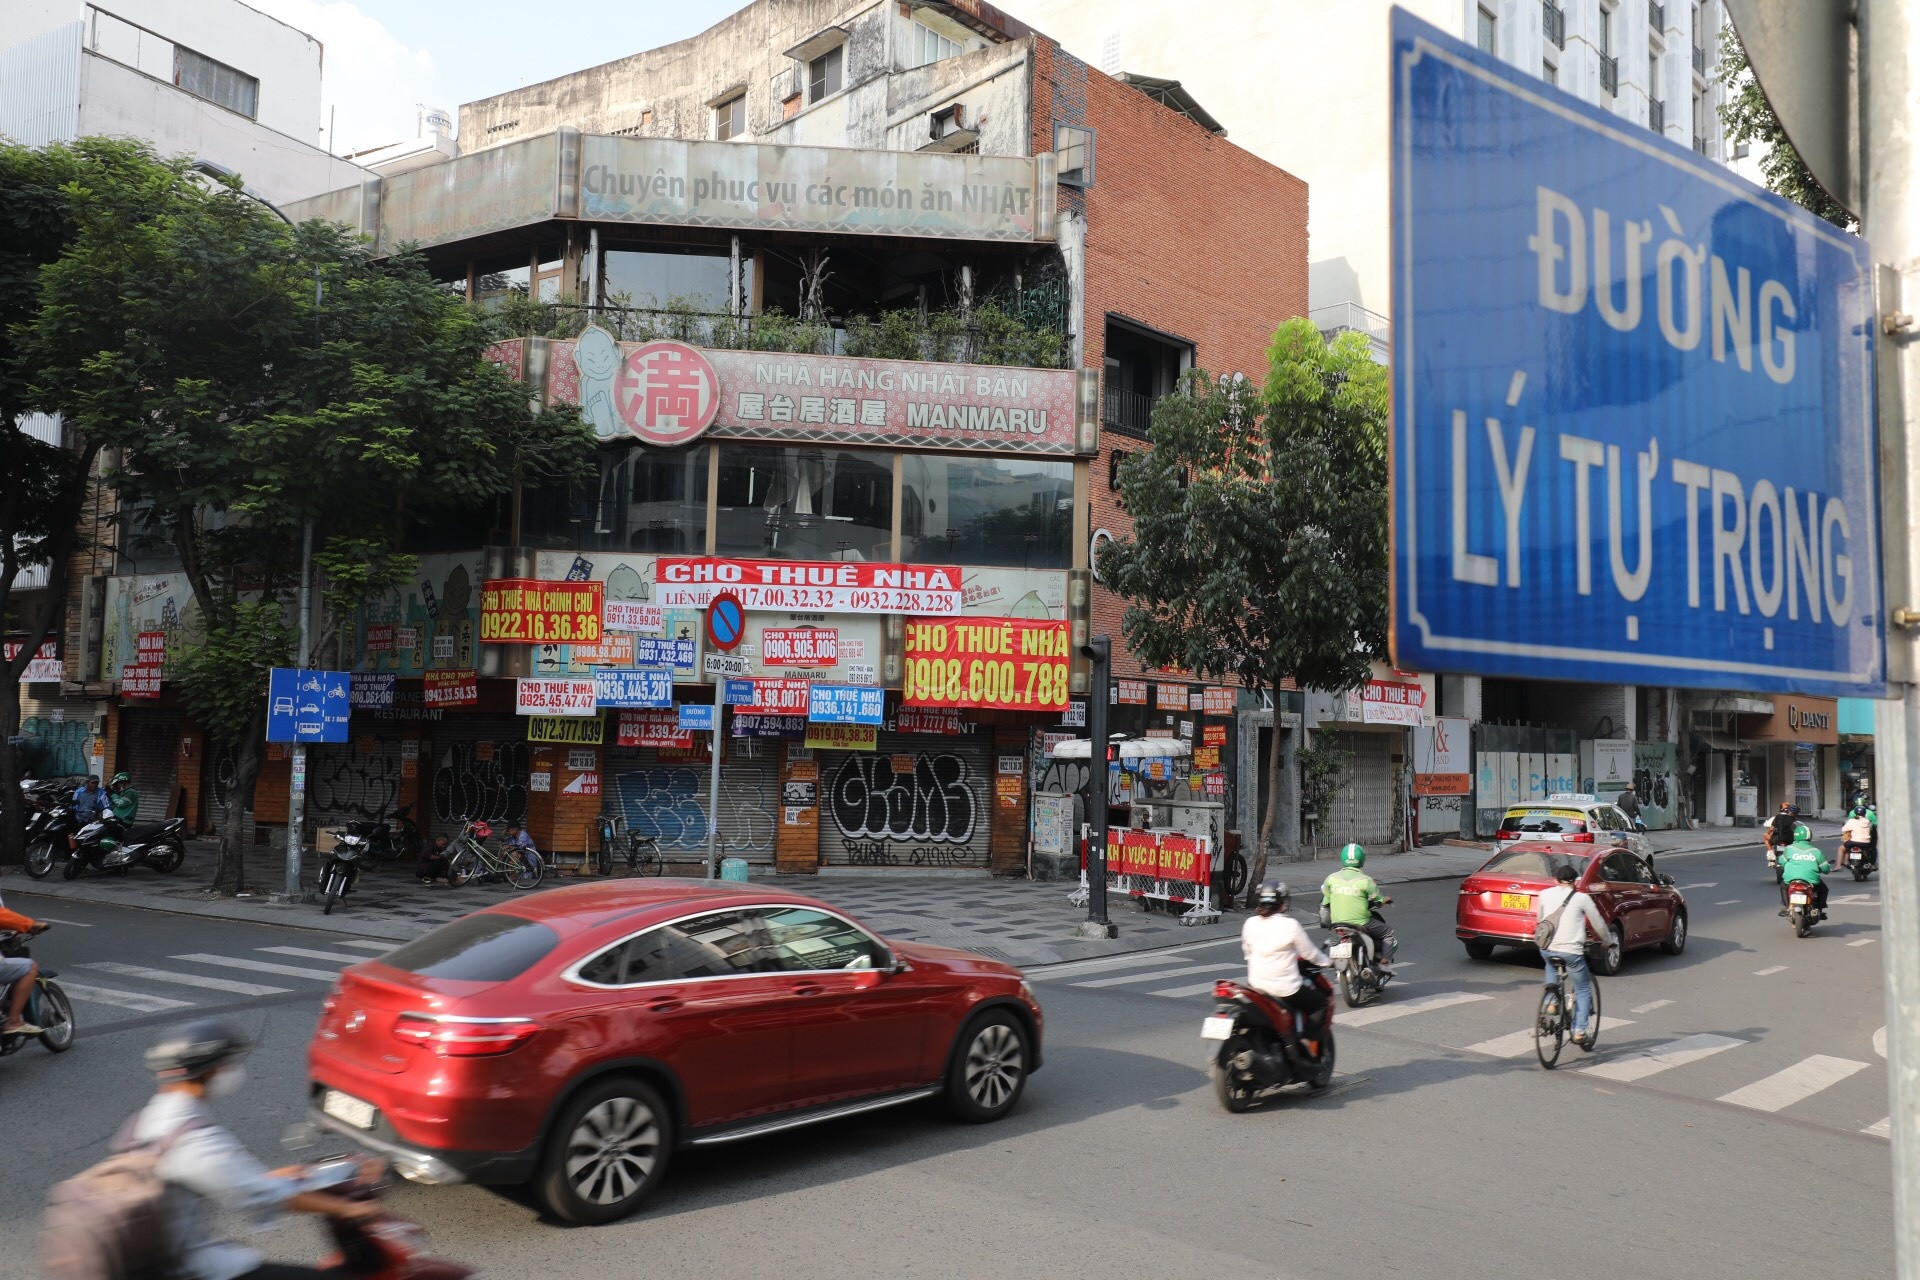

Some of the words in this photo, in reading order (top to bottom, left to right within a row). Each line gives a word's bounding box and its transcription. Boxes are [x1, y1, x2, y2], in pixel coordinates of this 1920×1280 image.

[584, 163, 685, 206] Chuyên
[765, 181, 797, 212] vụ
[805, 176, 847, 206] các
[853, 176, 913, 210] món
[920, 180, 953, 212] ăn
[960, 184, 1030, 221] NHẬT
[1528, 185, 1796, 385] ĐƯỜNG
[756, 361, 814, 388] NHÀ
[819, 362, 895, 391] HÀNG
[901, 369, 971, 402] NHẬT
[976, 366, 1029, 398] BẢN
[737, 393, 888, 427] 屋台居酒屋
[906, 400, 1048, 435] MANMARU
[1452, 370, 1535, 590] LÝ
[1559, 436, 1660, 642] TỰ
[1672, 459, 1853, 650] TRỌNG
[666, 564, 742, 584] CHO
[756, 564, 859, 587] THUÊ
[874, 566, 953, 590] NHÀ
[482, 591, 499, 611] CHO
[501, 585, 523, 611] THUÊ
[525, 587, 542, 611] NHÀ
[543, 587, 572, 612] CHÍNH
[666, 589, 697, 605] LIÊN
[850, 590, 954, 612] 0932.228.228
[607, 605, 622, 614] CHO
[625, 604, 644, 615] THUÊ
[646, 605, 661, 616] NHÀ
[480, 612, 598, 641] 0922.16.36.36
[606, 613, 661, 627] 0911.33.99.04
[139, 634, 151, 649] NHÀ
[152, 634, 164, 650] BÁN
[615, 636, 631, 646] NHÀ
[788, 631, 812, 639] THUÊ
[815, 630, 836, 639] NHÀ
[905, 623, 948, 653] CHO
[955, 621, 1014, 655] THUÊ
[1021, 624, 1068, 657] NHÀ
[576, 645, 631, 659] 0906.98.0017
[640, 640, 655, 649] CHO
[657, 639, 675, 649] THUÊ
[677, 640, 693, 651] NHÀ
[764, 640, 836, 659] 0906.905.006
[639, 648, 693, 663] 0931.432.469
[363, 674, 376, 682] BÁN
[425, 672, 440, 680] NHÀ
[441, 671, 455, 680] CHO
[457, 670, 475, 680] THUÊ
[597, 672, 618, 681] CHO
[622, 671, 646, 681] THUÊ
[649, 671, 671, 681] NHÀ
[784, 671, 826, 680] MANMARU
[905, 657, 1068, 706] 0908.600.788
[354, 683, 367, 691] CHO
[369, 682, 387, 691] THUÊ
[519, 682, 541, 693] CHO
[544, 681, 569, 694] THUÊ
[573, 682, 594, 694] NHÀ
[597, 681, 671, 701] 0936.445.201
[760, 680, 784, 688] THUÊ
[787, 680, 808, 688] NHÀ
[1157, 685, 1166, 693] CHO
[424, 686, 477, 702] 0942.33.58.33
[519, 694, 594, 708] 0925.45.47.47
[812, 690, 831, 701] CHO
[835, 689, 858, 702] THUÊ
[861, 688, 881, 703] NHÀ
[1204, 690, 1213, 698] CHO
[1364, 685, 1382, 701] CHO
[1384, 685, 1406, 704] THUÊ
[1408, 689, 1422, 705] NH
[374, 708, 444, 720] RESTAURANT
[812, 701, 881, 716] 0936.141.660
[620, 713, 632, 721] CHO
[634, 712, 648, 722] THUÊ
[650, 713, 662, 722] NHÀ
[680, 718, 699, 727] TRƯƠNG
[736, 715, 804, 731] 0907.594.883
[899, 714, 920, 727] 0911
[923, 715, 945, 729] 7777
[947, 717, 959, 730] 69
[531, 718, 602, 742] 0972.377.039
[619, 723, 691, 739] 0931.339.227
[807, 727, 875, 742] 0919.04.38.38
[1435, 719, 1450, 753] &
[1435, 755, 1450, 765] AND
[1129, 844, 1147, 869] VỰC
[1174, 847, 1194, 875] TẬP
[1791, 853, 1817, 862] Grab
[1331, 884, 1361, 897] Grab
